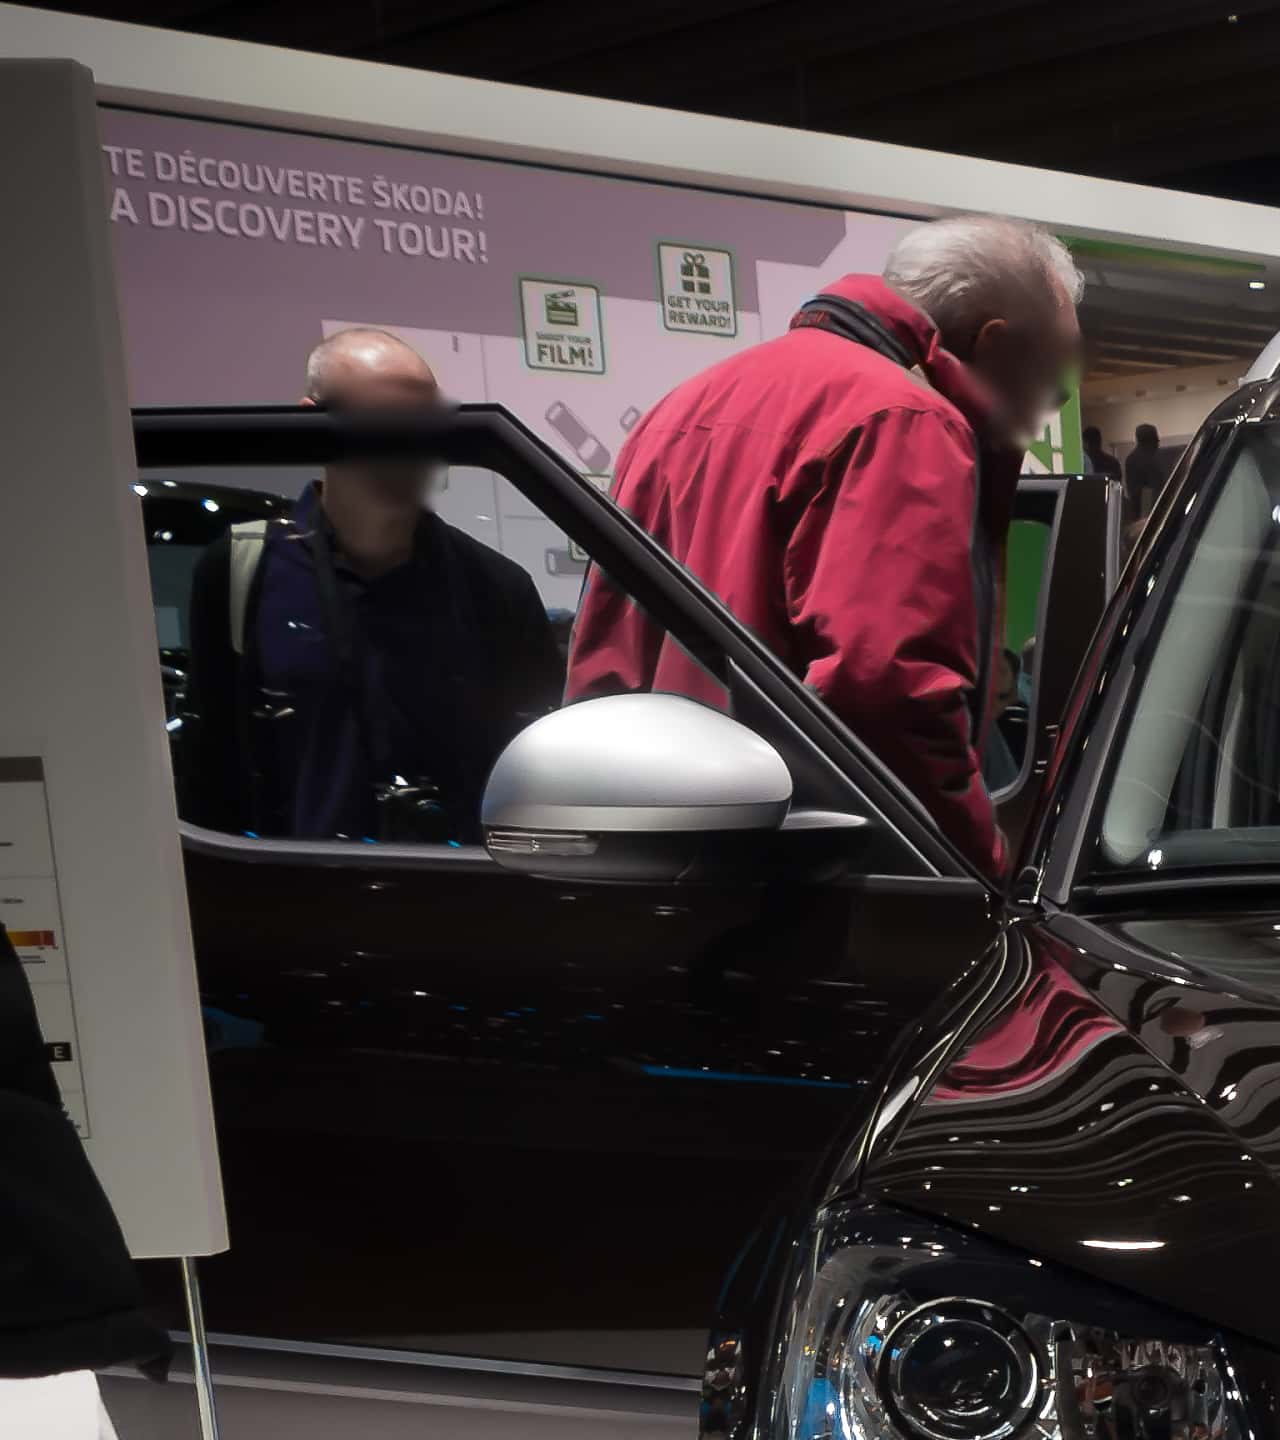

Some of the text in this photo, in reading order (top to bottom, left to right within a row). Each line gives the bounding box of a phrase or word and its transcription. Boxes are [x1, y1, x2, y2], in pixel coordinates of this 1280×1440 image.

[102, 145, 484, 220] TE DÉCOUVERTE ŠKODA!
[110, 187, 489, 264] A DISCOVERY TOUR!
[667, 295, 729, 313] GET YOUR
[536, 343, 595, 367] FILM!
